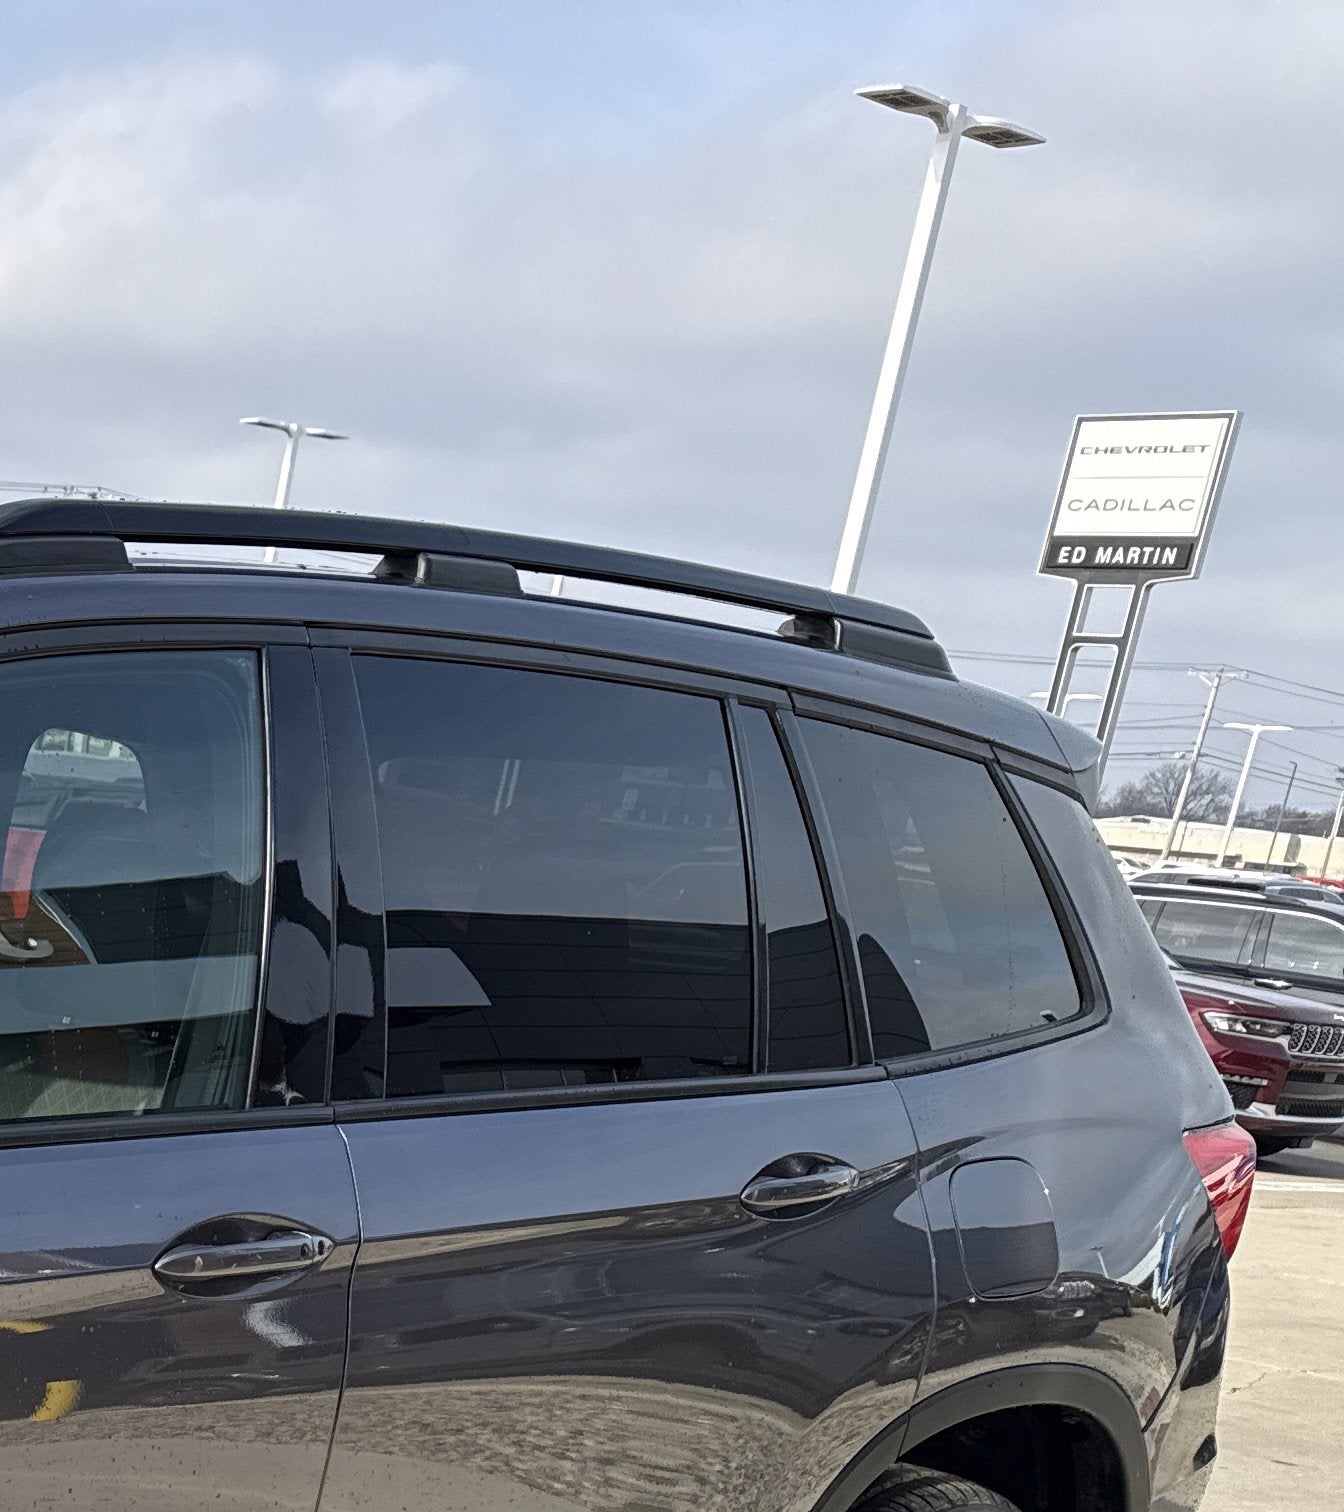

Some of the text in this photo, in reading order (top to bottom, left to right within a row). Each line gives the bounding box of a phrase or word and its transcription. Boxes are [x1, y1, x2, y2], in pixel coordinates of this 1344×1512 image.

[1079, 444, 1211, 456] CHEVROLET
[1067, 498, 1196, 513] CADILLAC
[1057, 546, 1178, 565] ED MARTIN
